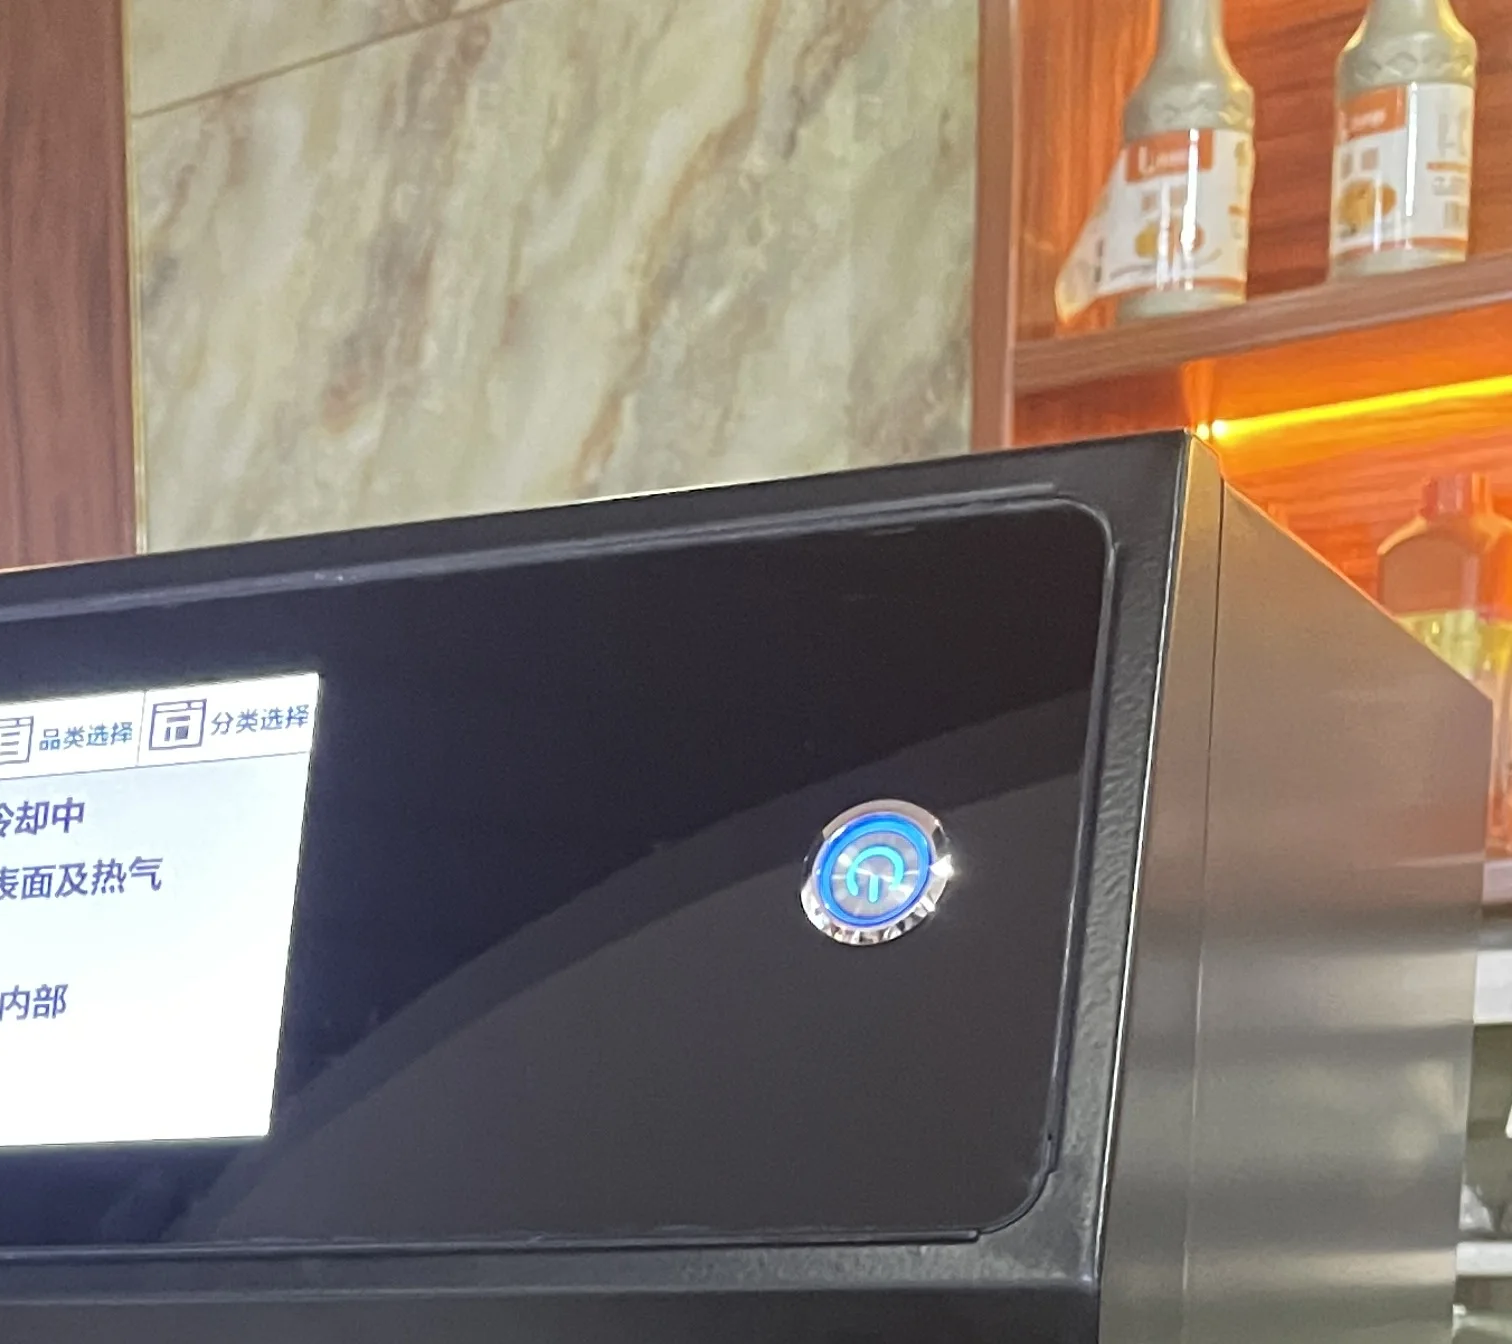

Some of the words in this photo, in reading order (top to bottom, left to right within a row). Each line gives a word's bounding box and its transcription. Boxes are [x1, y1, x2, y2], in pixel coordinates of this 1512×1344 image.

[210, 705, 310, 735] 分类选择
[39, 722, 133, 751] 品类选择
